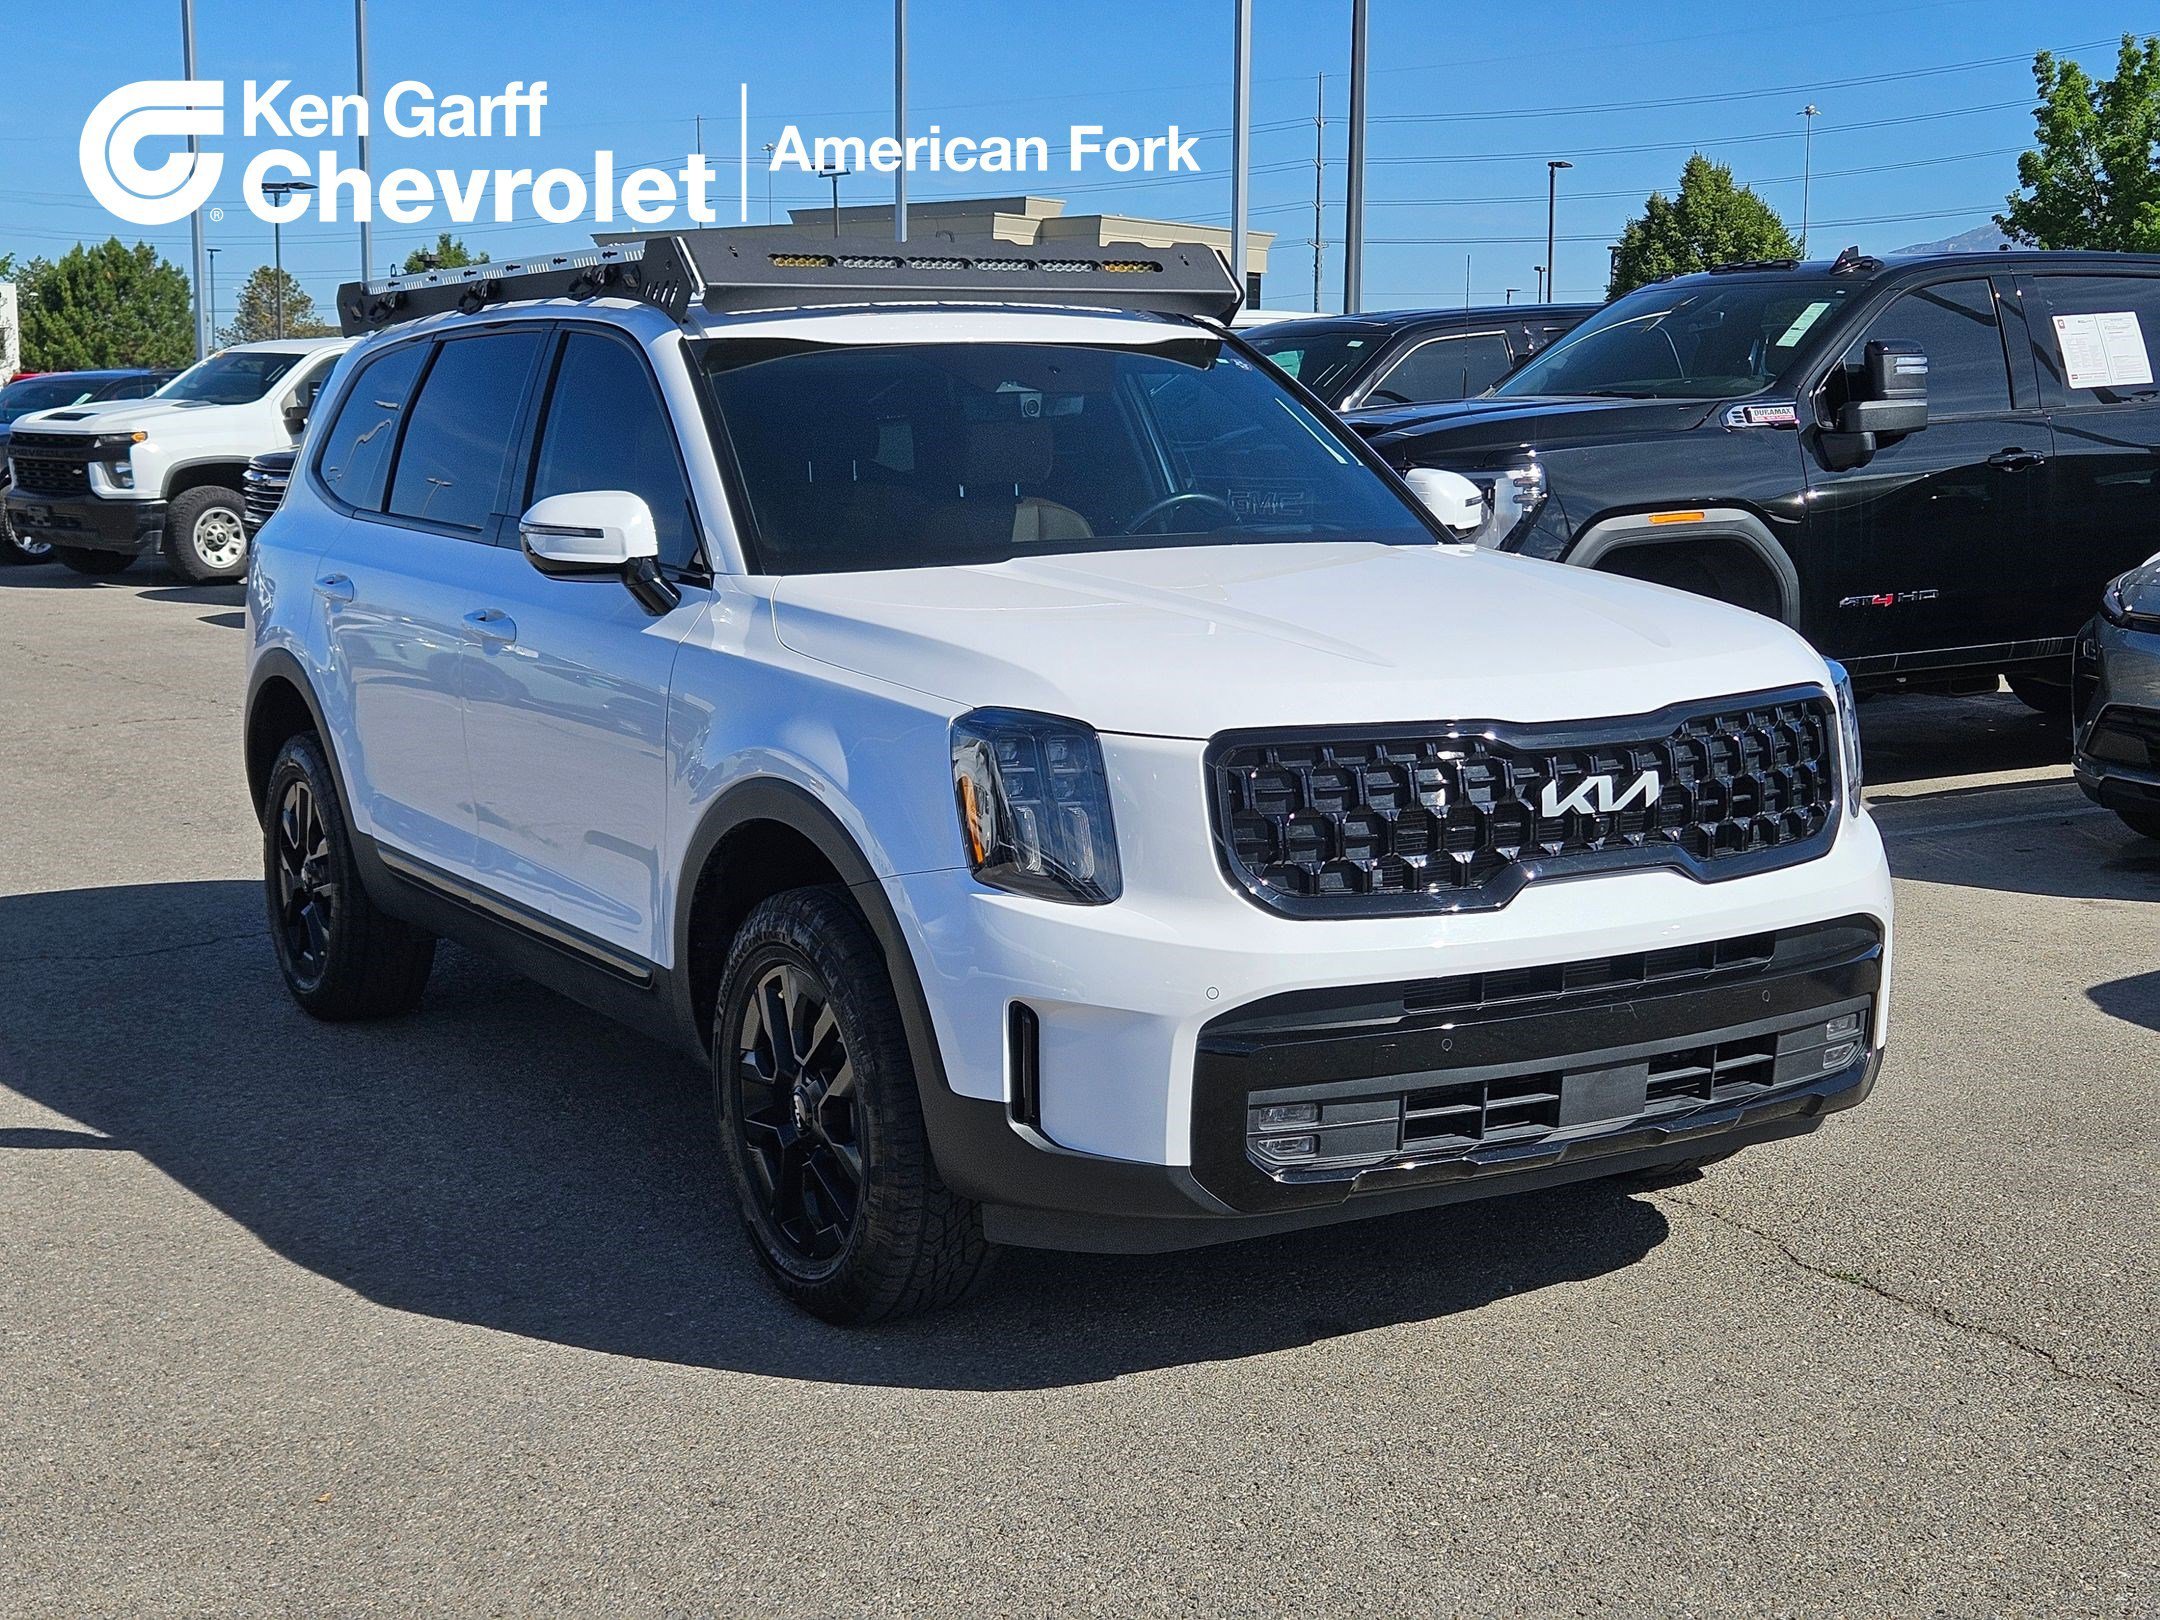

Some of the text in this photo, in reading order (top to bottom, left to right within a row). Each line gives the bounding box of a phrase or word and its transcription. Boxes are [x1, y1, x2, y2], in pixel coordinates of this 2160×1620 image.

[1753, 407, 1793, 416] DURAMAX
[1228, 489, 1305, 517] GMC
[1897, 589, 1940, 603] HD
[1541, 770, 1660, 818] KIA
